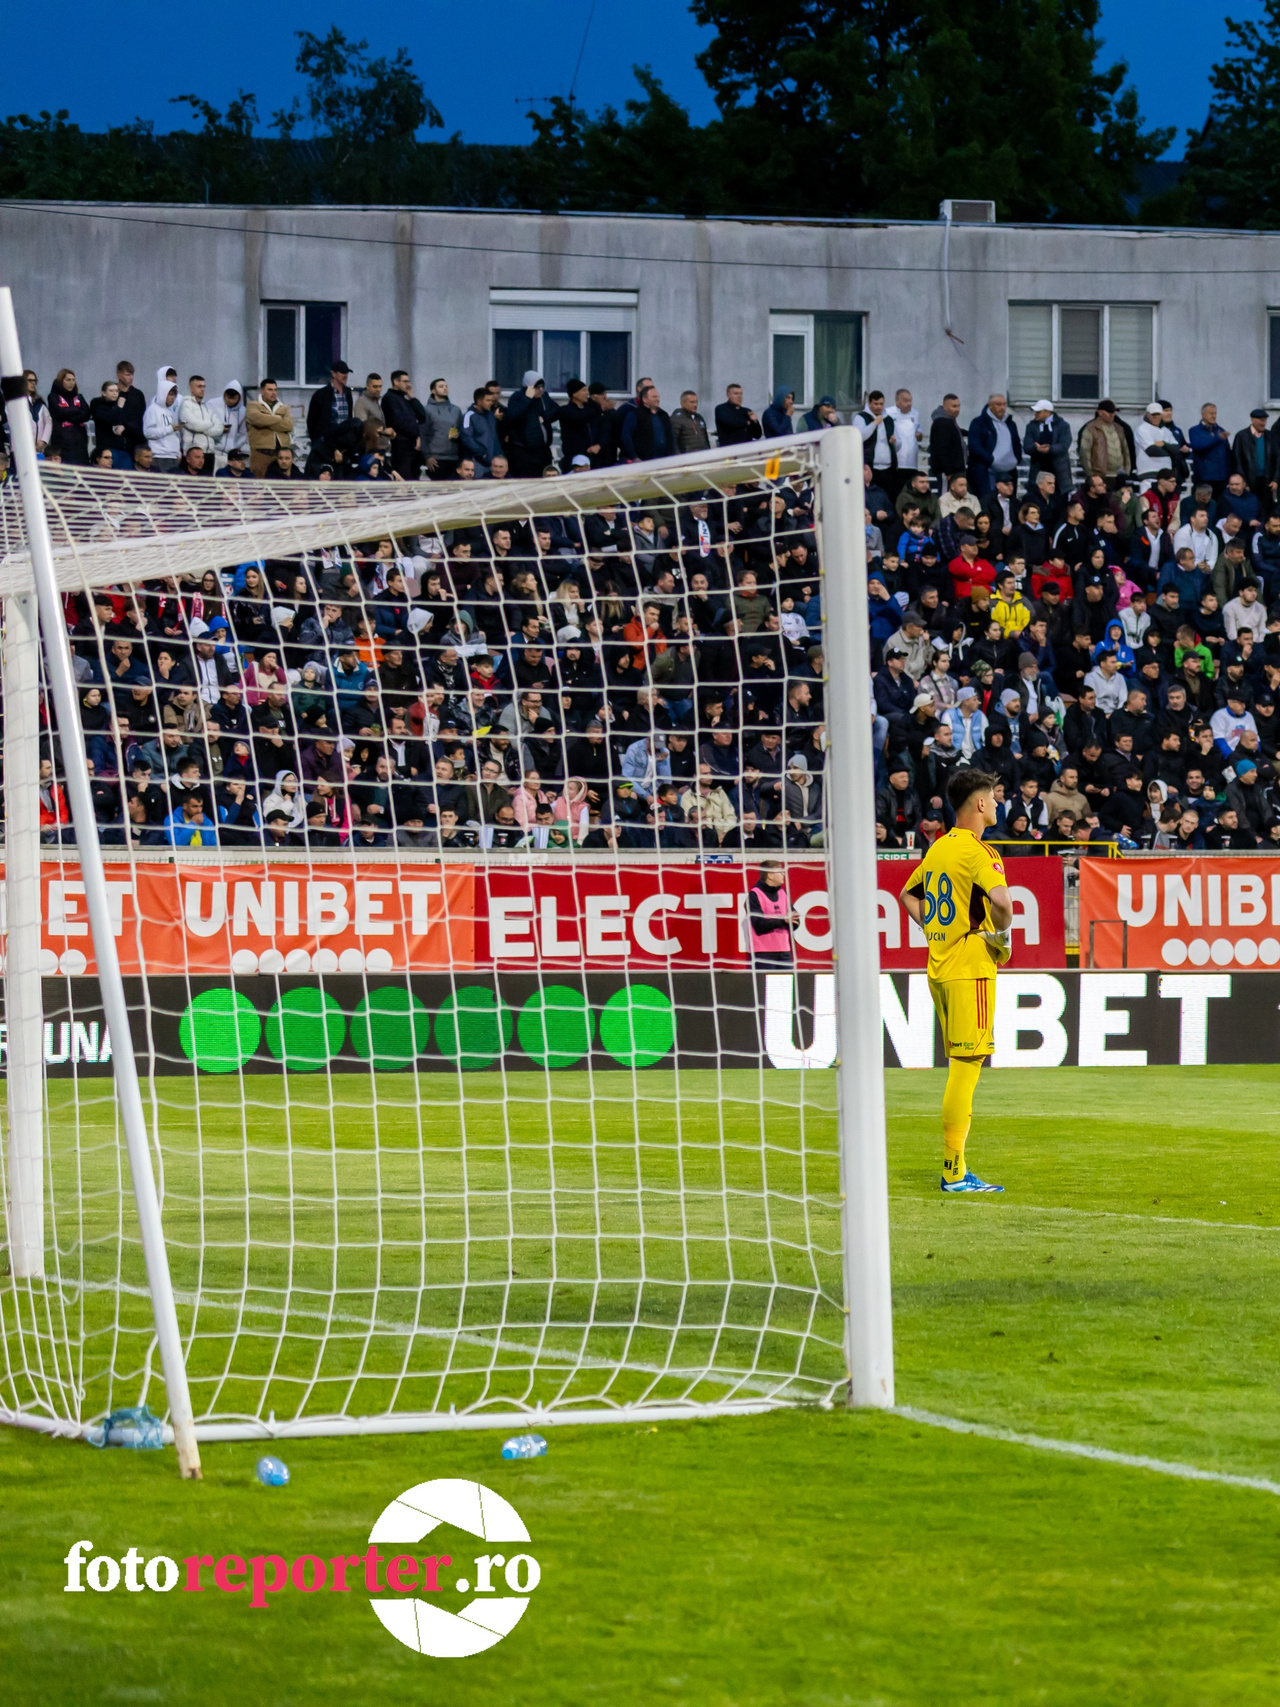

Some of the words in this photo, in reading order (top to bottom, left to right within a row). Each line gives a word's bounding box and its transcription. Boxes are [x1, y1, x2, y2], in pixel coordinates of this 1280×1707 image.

[184, 880, 441, 937] UNIBET
[924, 871, 956, 926] 68
[765, 972, 1232, 1069] UNBET
